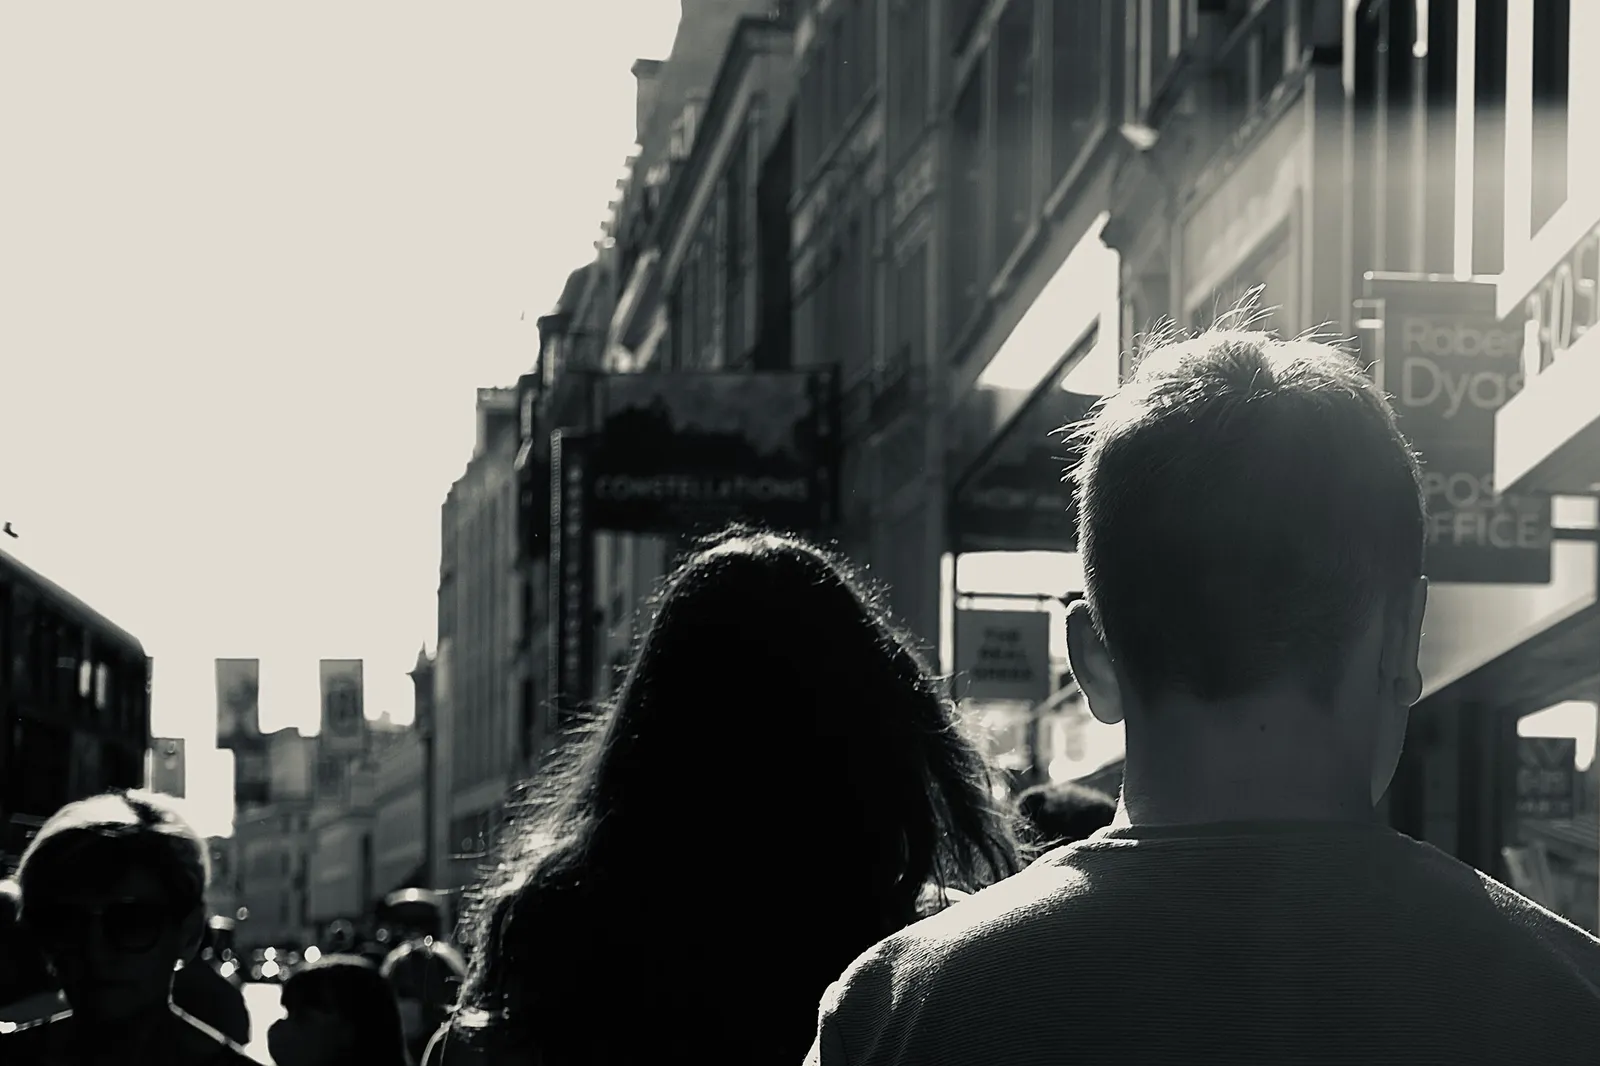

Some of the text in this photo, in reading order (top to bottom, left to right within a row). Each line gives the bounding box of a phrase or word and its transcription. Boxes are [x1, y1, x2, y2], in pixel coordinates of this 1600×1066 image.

[1403, 319, 1524, 357] Rober
[1422, 472, 1520, 508] POS
[1424, 512, 1541, 549] FFICE
